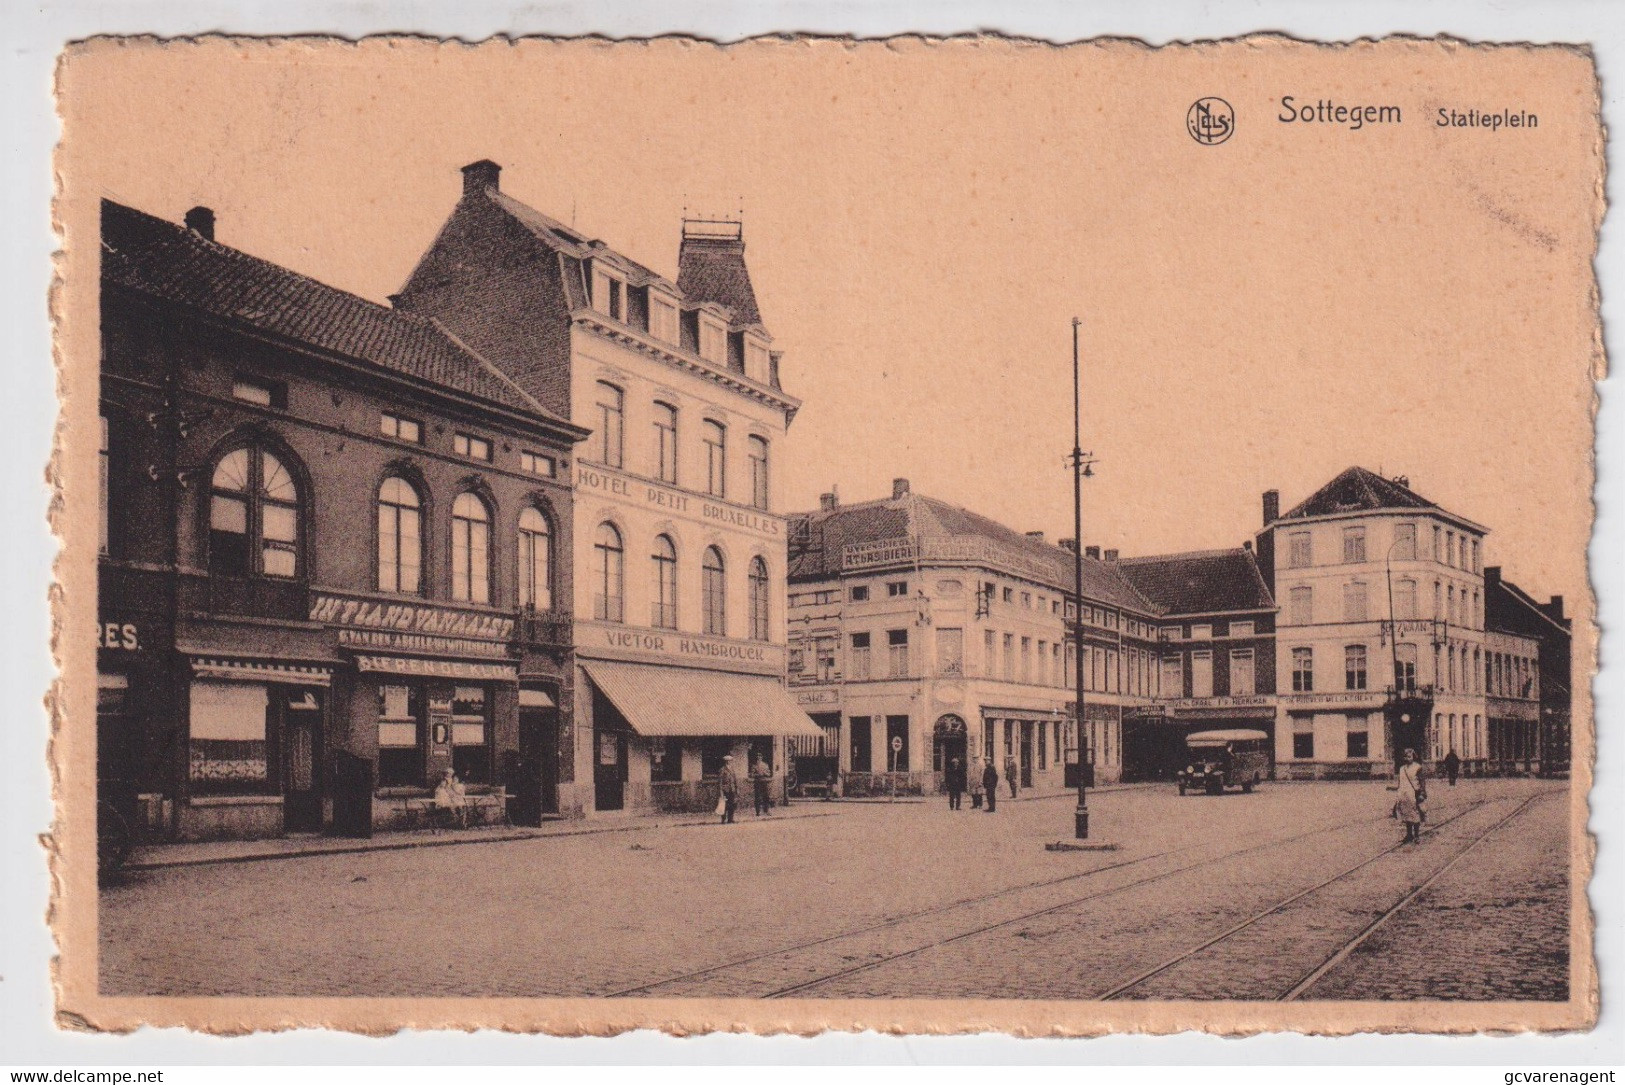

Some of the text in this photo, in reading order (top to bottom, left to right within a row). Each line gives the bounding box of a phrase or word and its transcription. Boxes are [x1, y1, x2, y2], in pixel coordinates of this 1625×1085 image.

[1278, 96, 1539, 132] Sottegem Statieplein
[577, 468, 779, 535] HOTEL PETIT BRUXELLES
[606, 631, 764, 661] VICTOR HAMBROUCK
